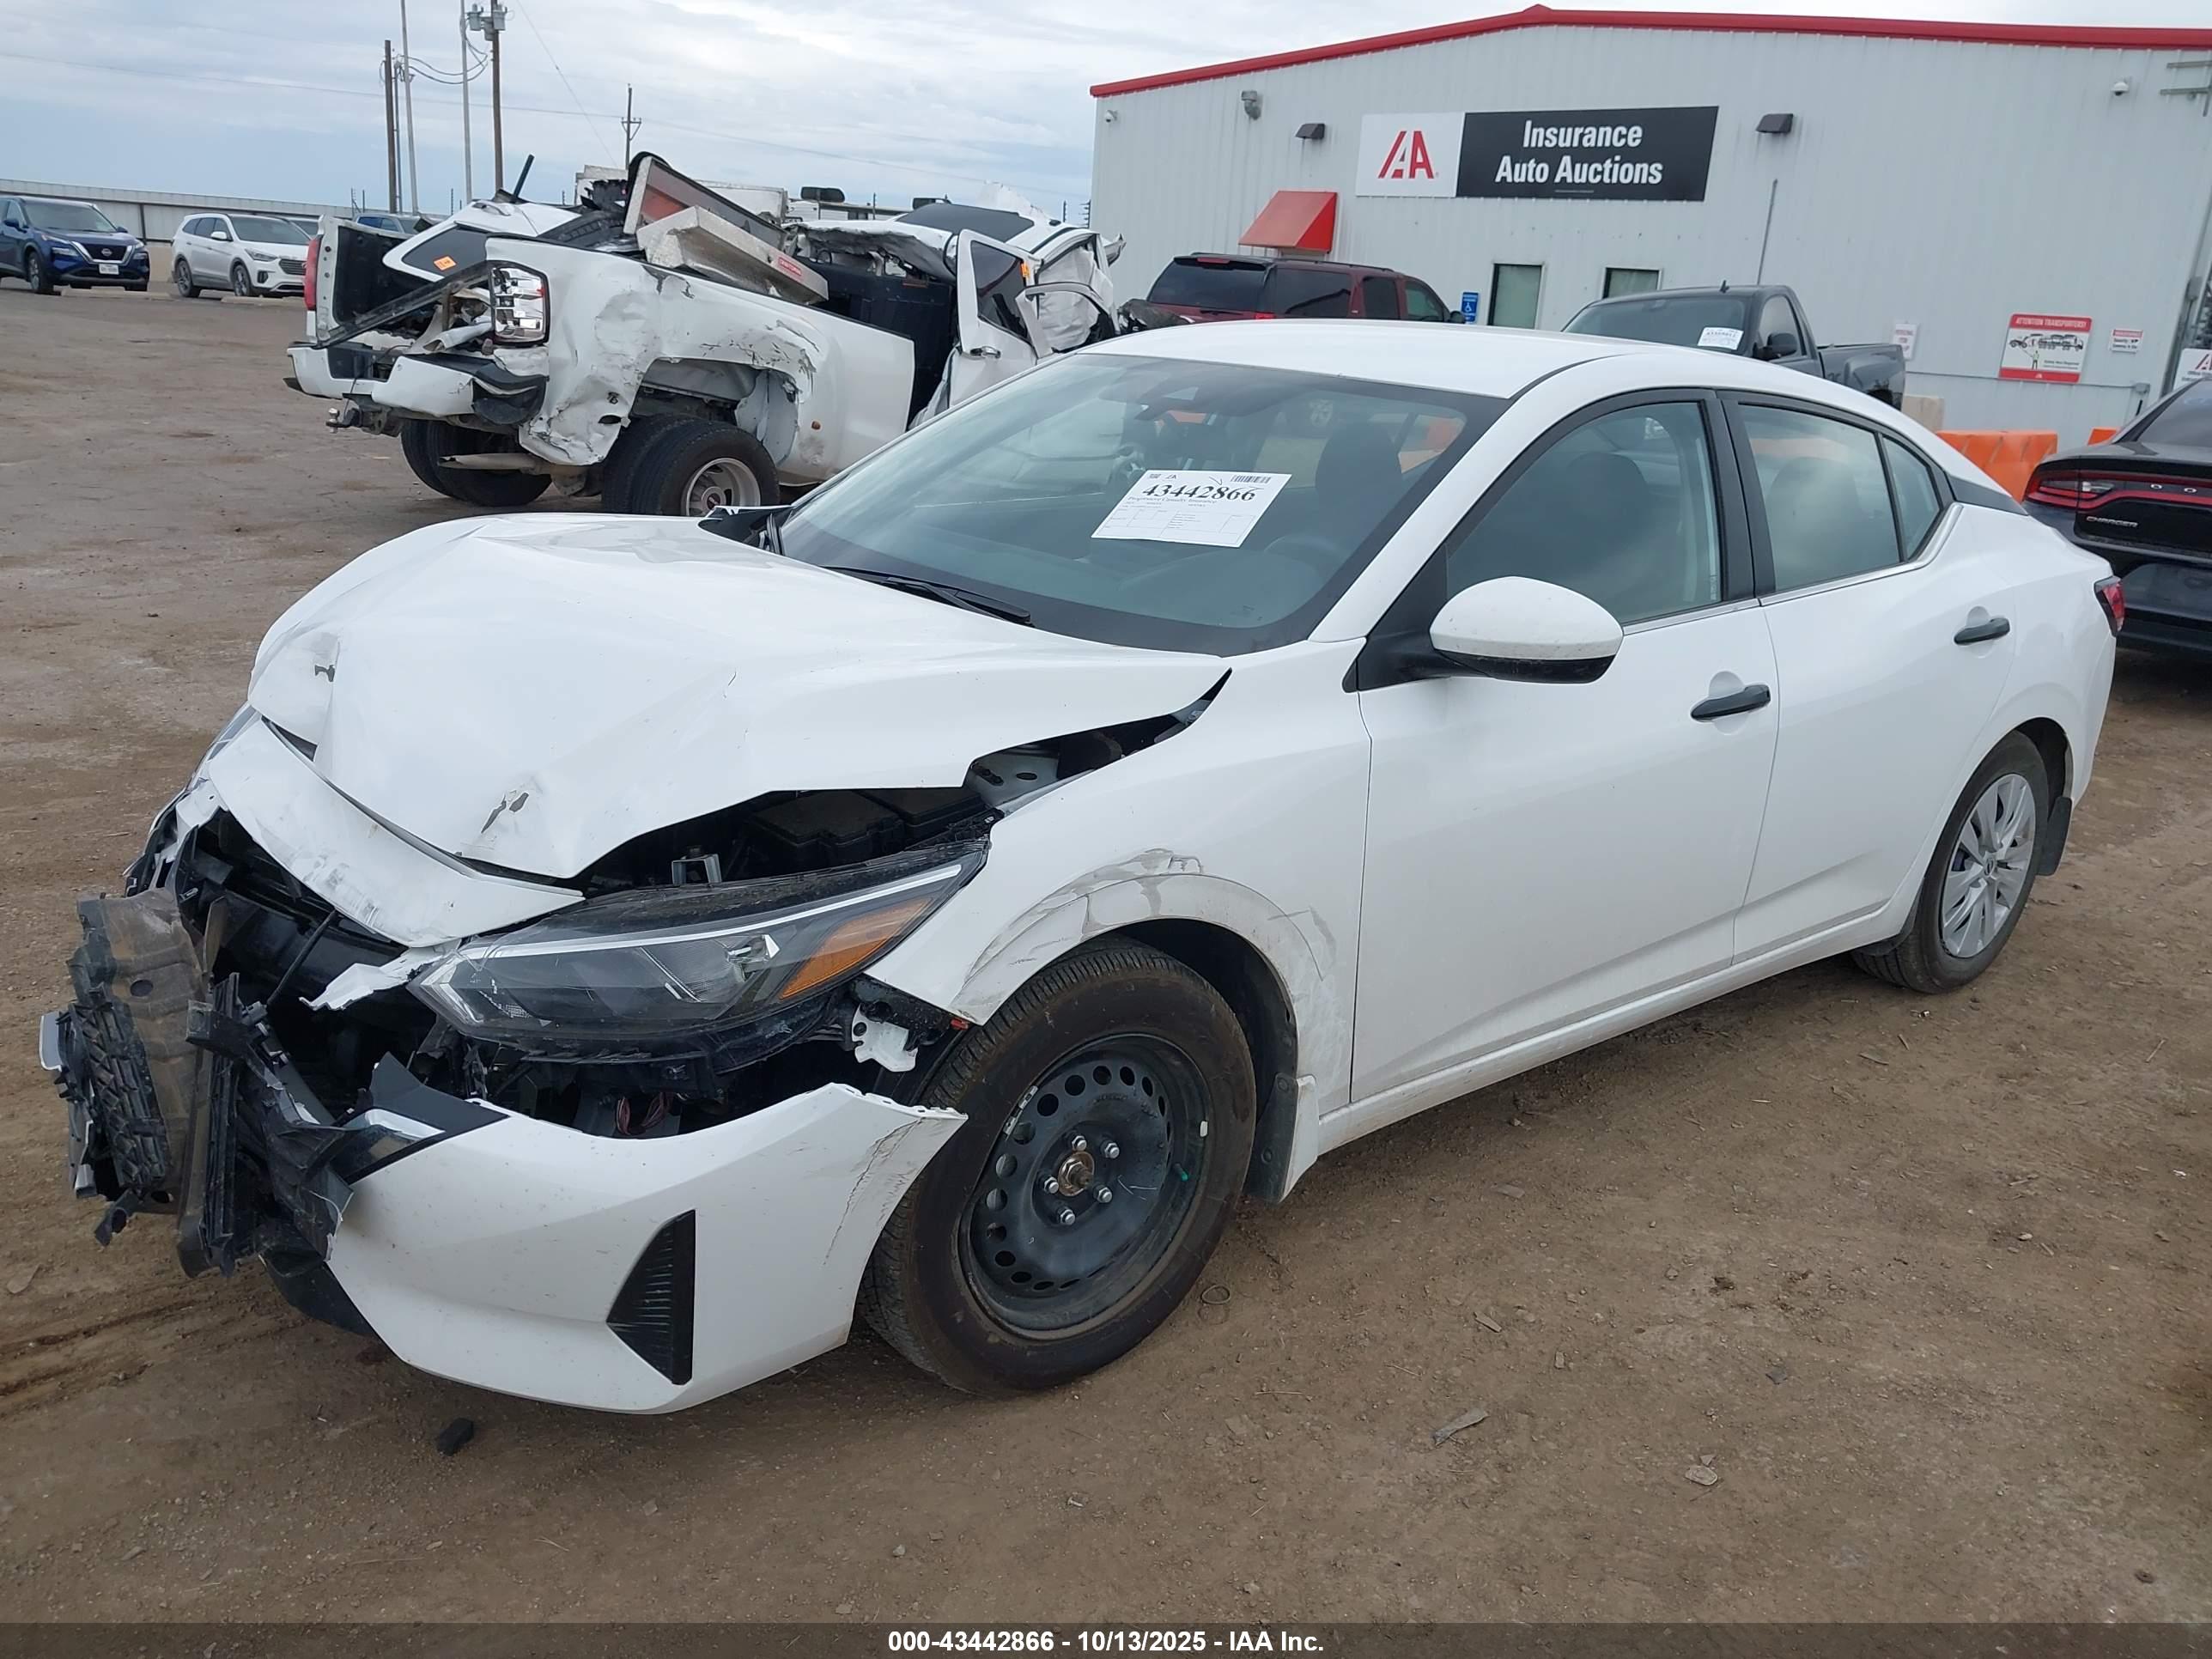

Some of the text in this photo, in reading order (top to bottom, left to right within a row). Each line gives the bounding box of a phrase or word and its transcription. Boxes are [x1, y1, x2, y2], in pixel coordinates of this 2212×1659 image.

[1523, 119, 1643, 148] Insurance
[1495, 155, 1663, 185] Auto Auctions
[1142, 483, 1257, 501] 43442866
[2086, 515, 2139, 528] CHARGER
